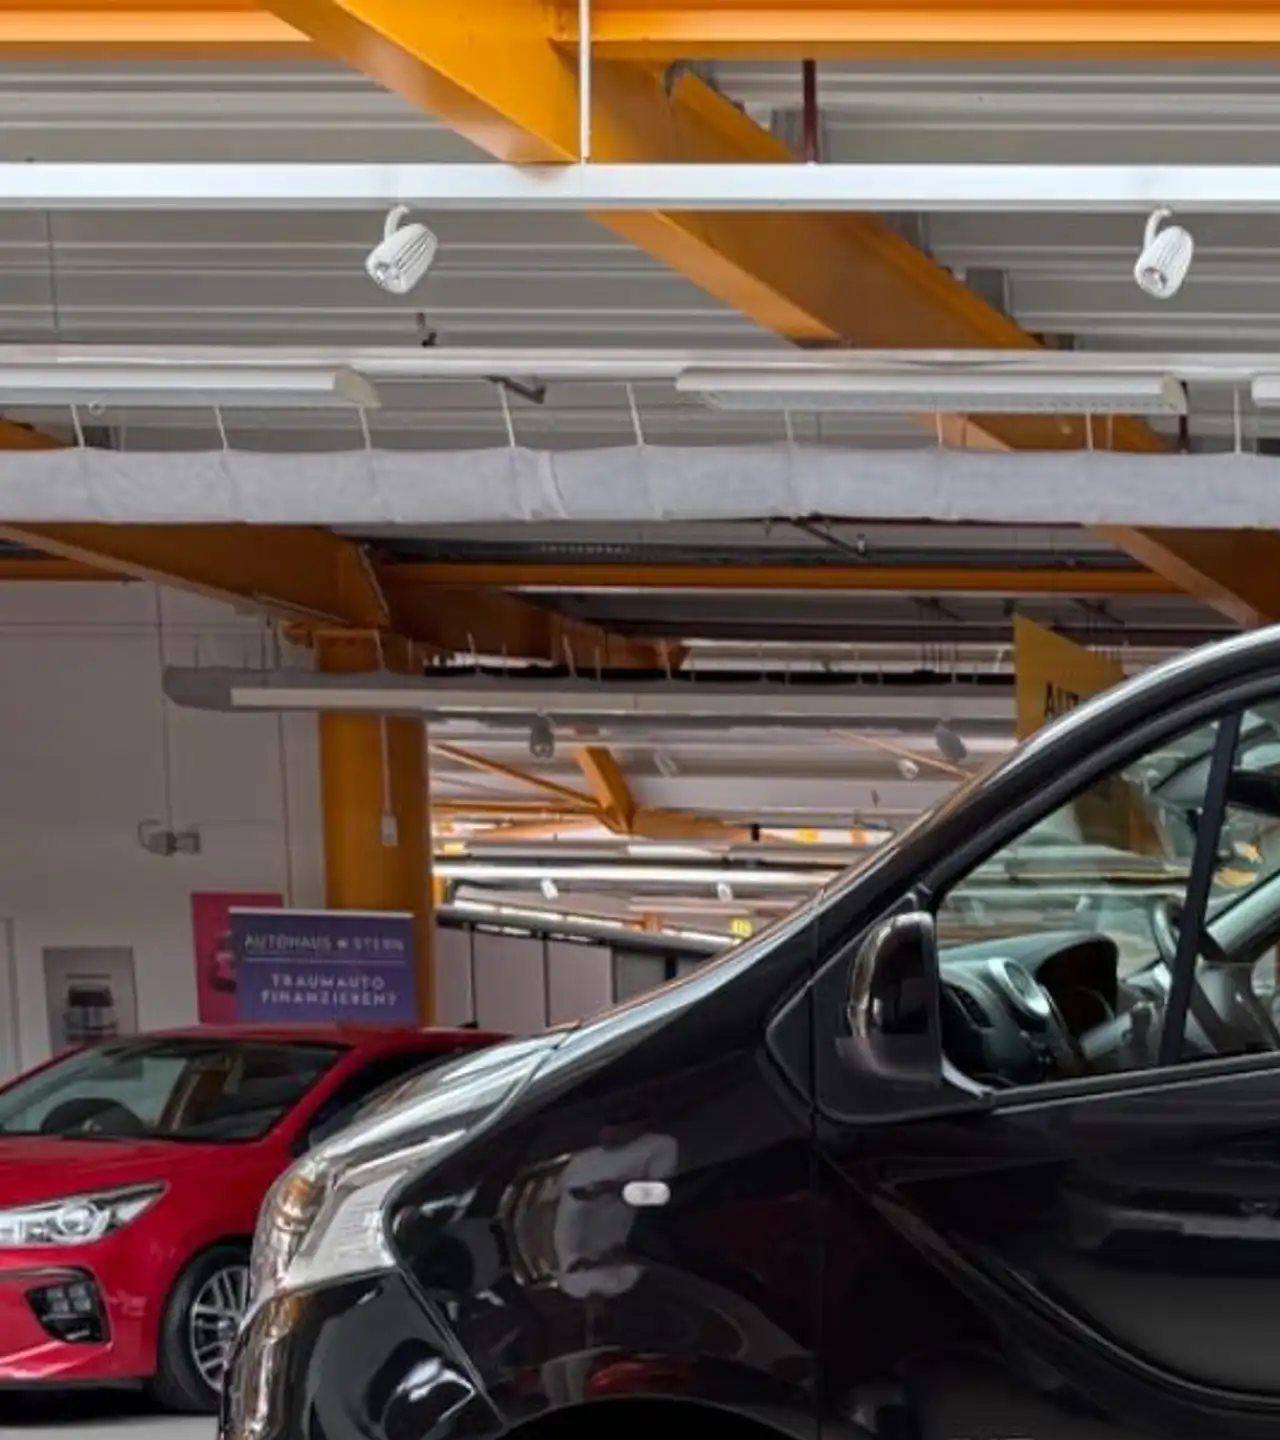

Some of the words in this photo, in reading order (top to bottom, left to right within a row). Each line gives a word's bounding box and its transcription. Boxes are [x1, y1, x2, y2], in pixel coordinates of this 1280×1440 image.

[245, 934, 332, 950] AUTOHAUS
[353, 936, 405, 951] STERN
[272, 973, 386, 990] TRAUMAUTO
